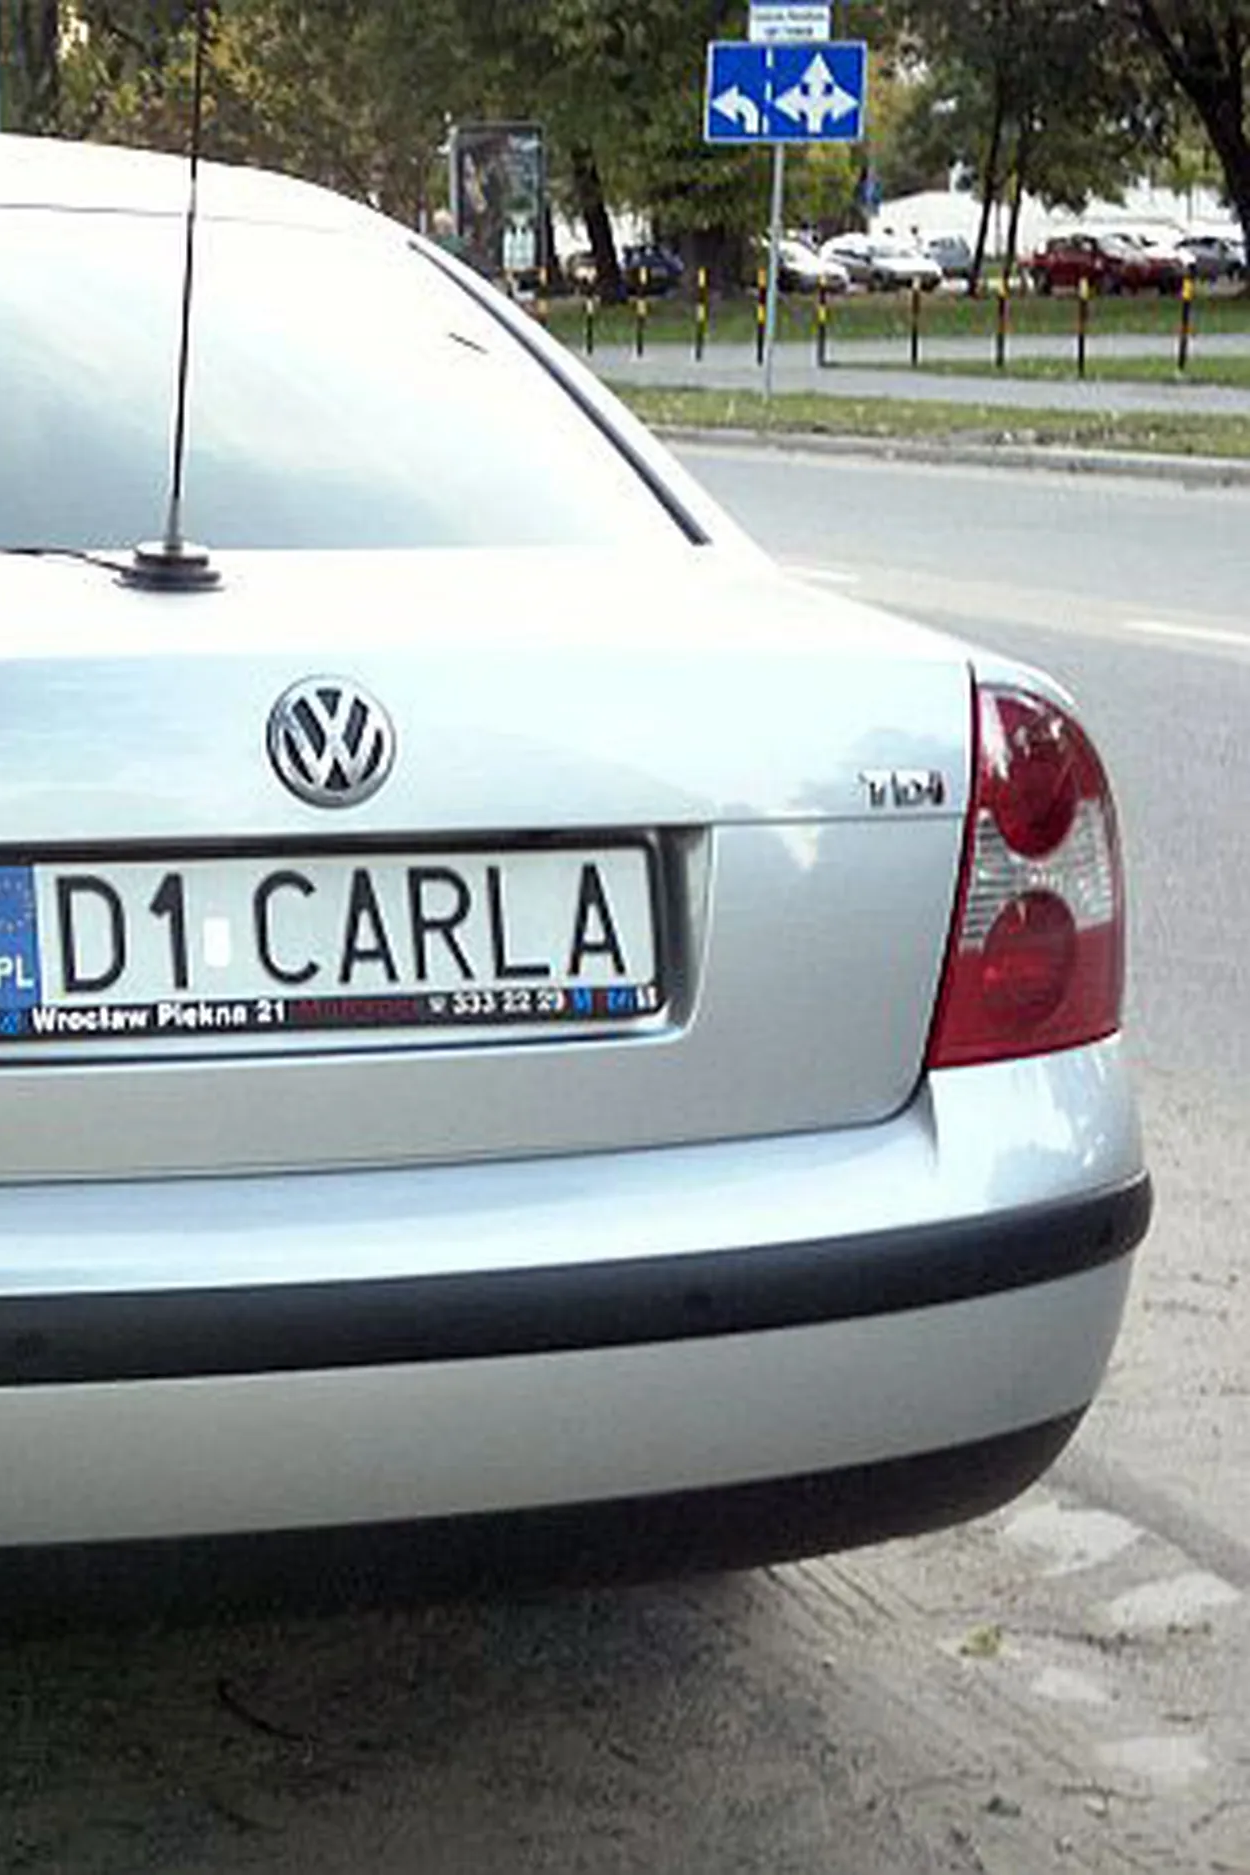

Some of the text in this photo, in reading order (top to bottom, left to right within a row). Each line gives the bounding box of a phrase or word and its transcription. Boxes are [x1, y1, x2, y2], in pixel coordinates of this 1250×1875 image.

[55, 862, 628, 994] D1 CARLA
[257, 999, 285, 1023] 21
